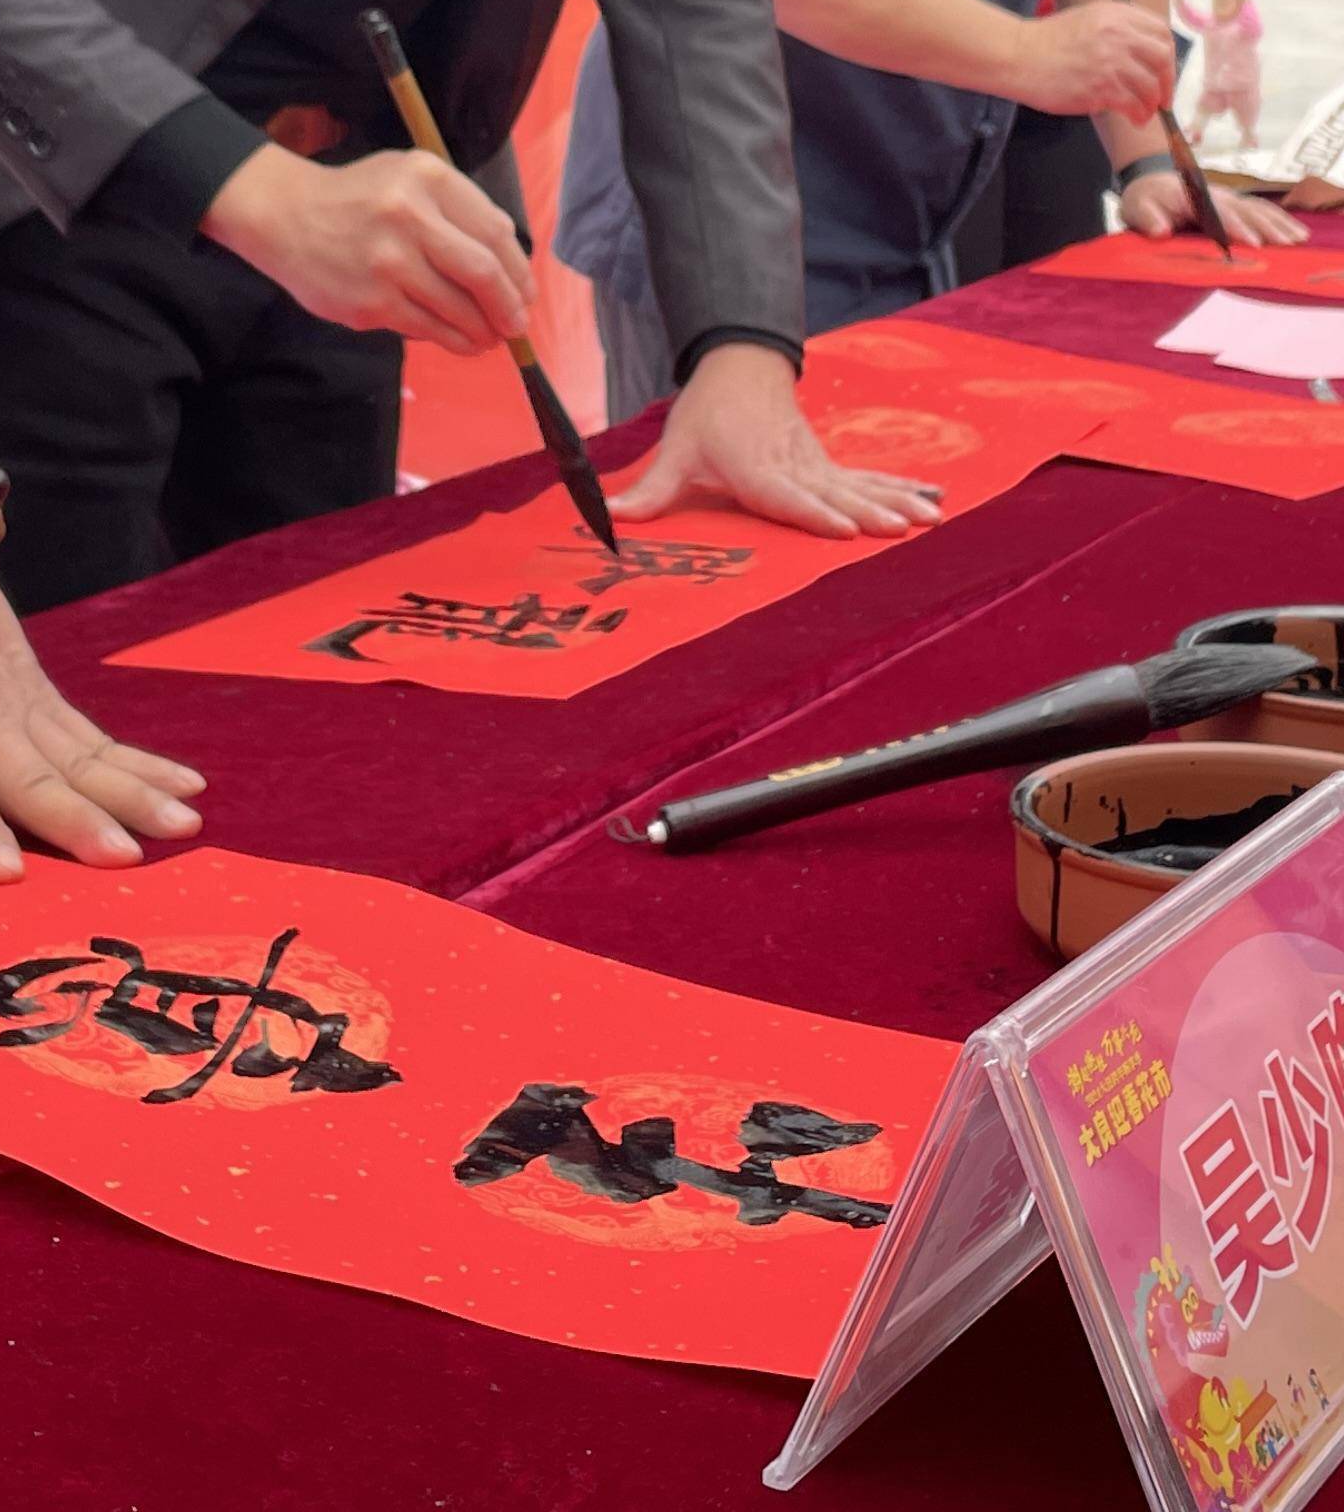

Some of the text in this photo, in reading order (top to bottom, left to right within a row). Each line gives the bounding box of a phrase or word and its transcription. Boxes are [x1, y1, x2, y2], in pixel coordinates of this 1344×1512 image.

[1078, 1059, 1173, 1168] 大良迎春花市
